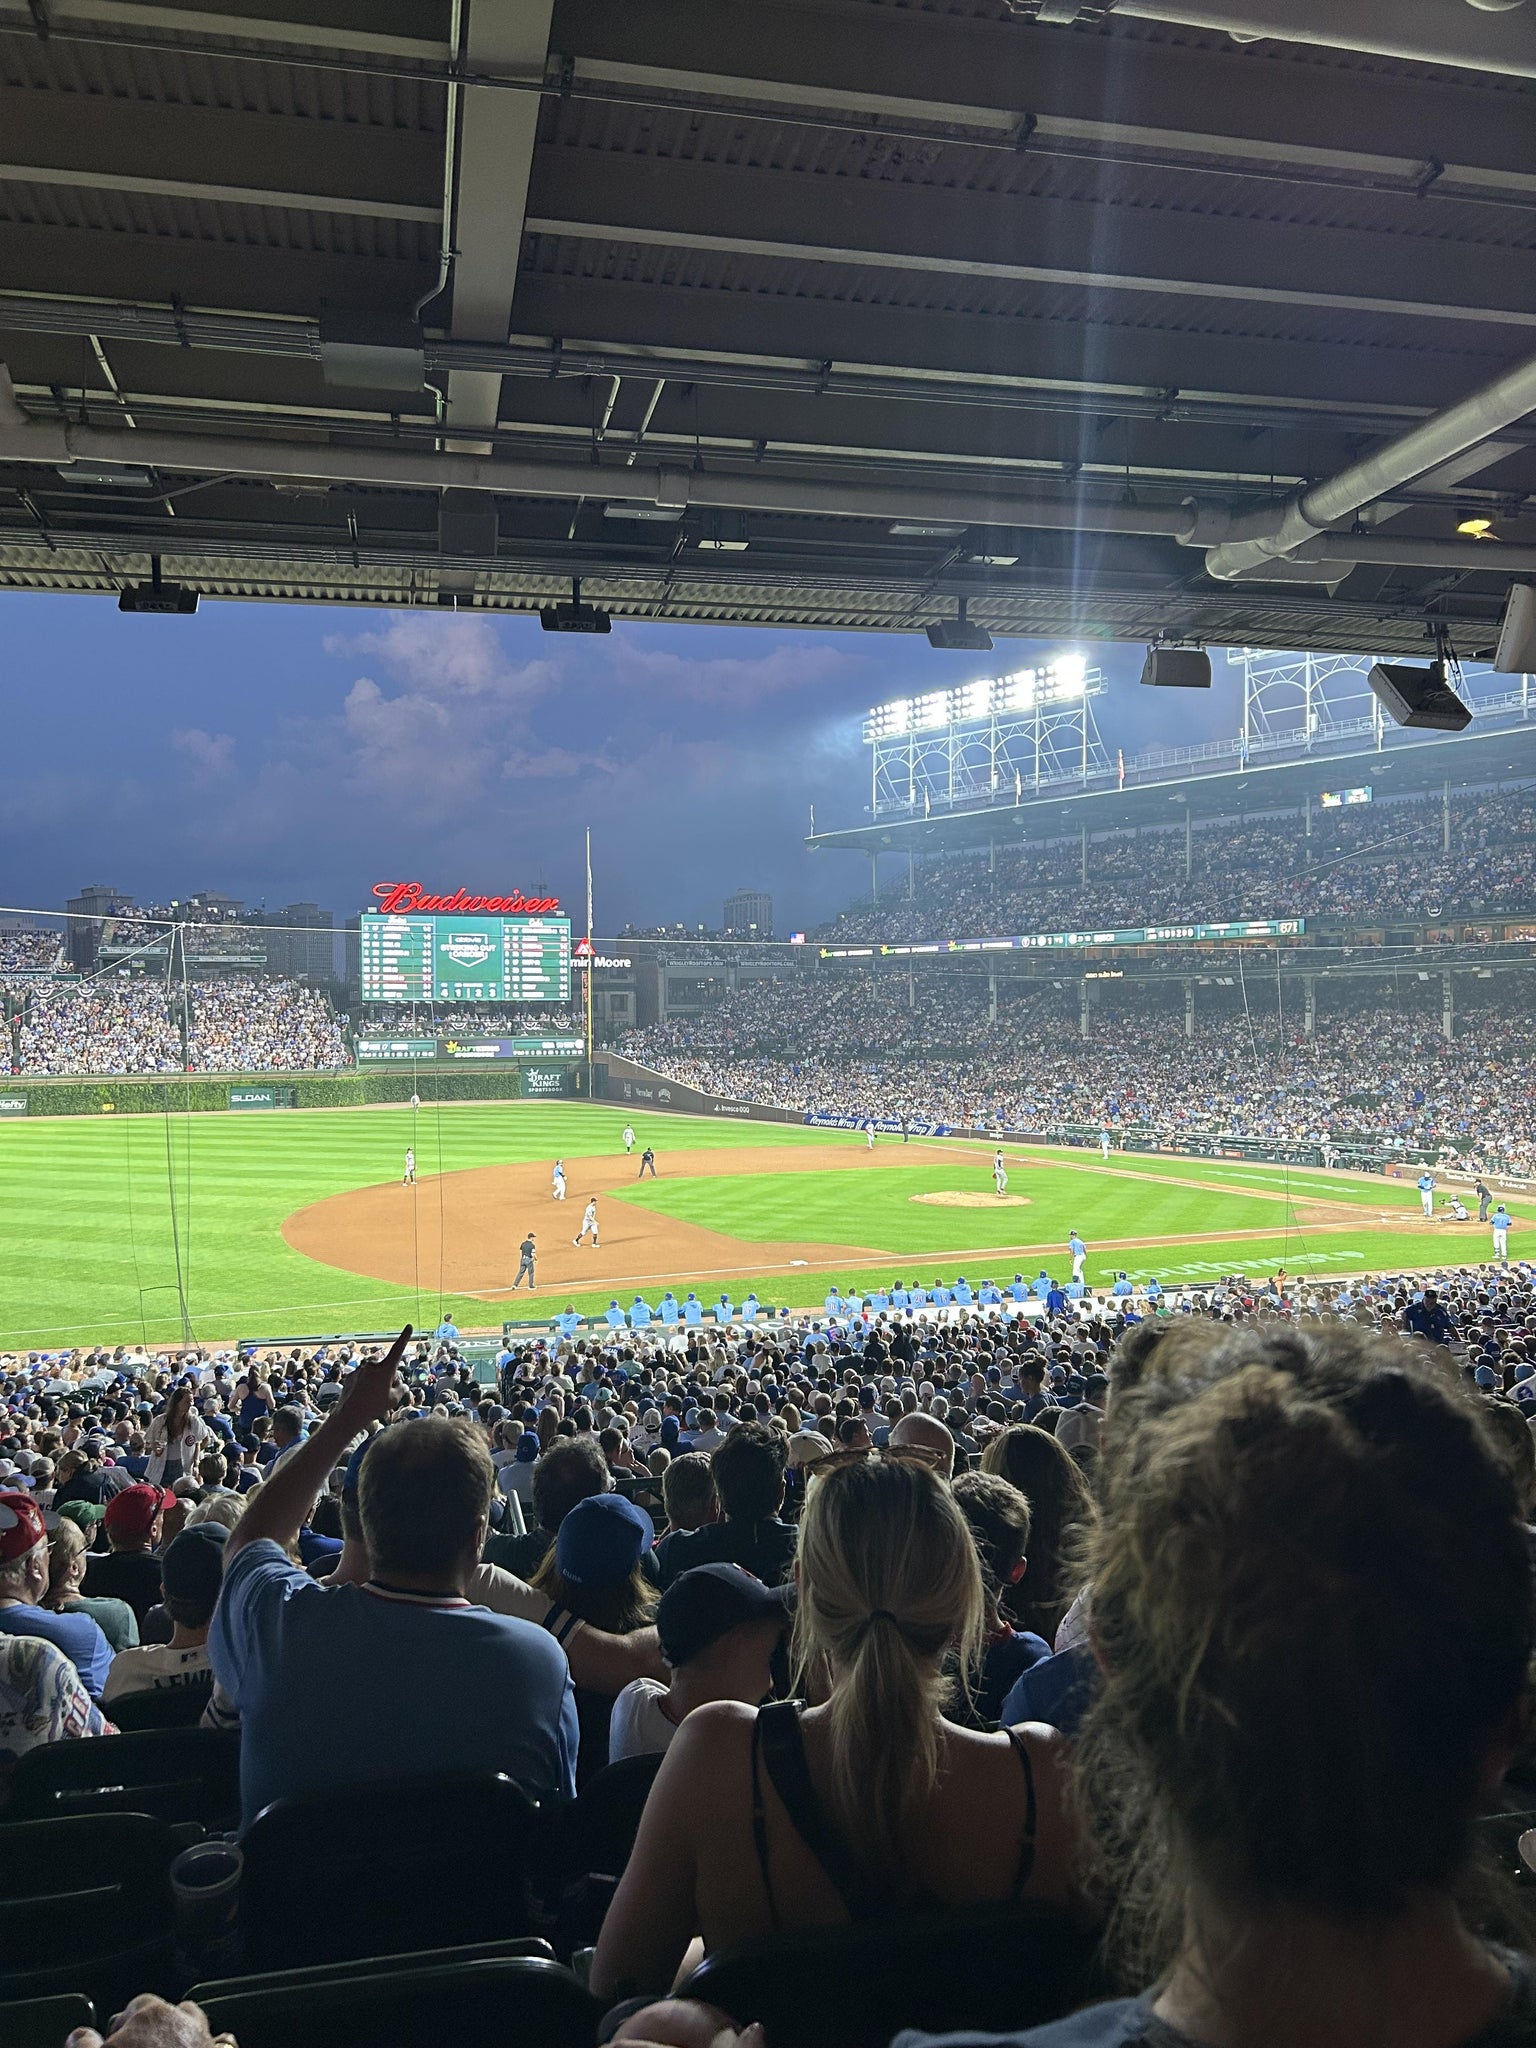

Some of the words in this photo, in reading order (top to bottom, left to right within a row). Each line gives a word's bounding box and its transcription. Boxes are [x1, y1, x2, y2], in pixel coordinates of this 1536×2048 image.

[373, 883, 559, 913] Budweiser
[594, 956, 632, 968] Moore
[527, 1073, 561, 1083] DRAFT
[809, 1116, 838, 1128] Reynolds
[838, 1119, 856, 1129] Wrap
[1099, 1252, 1330, 1280] Southwest
